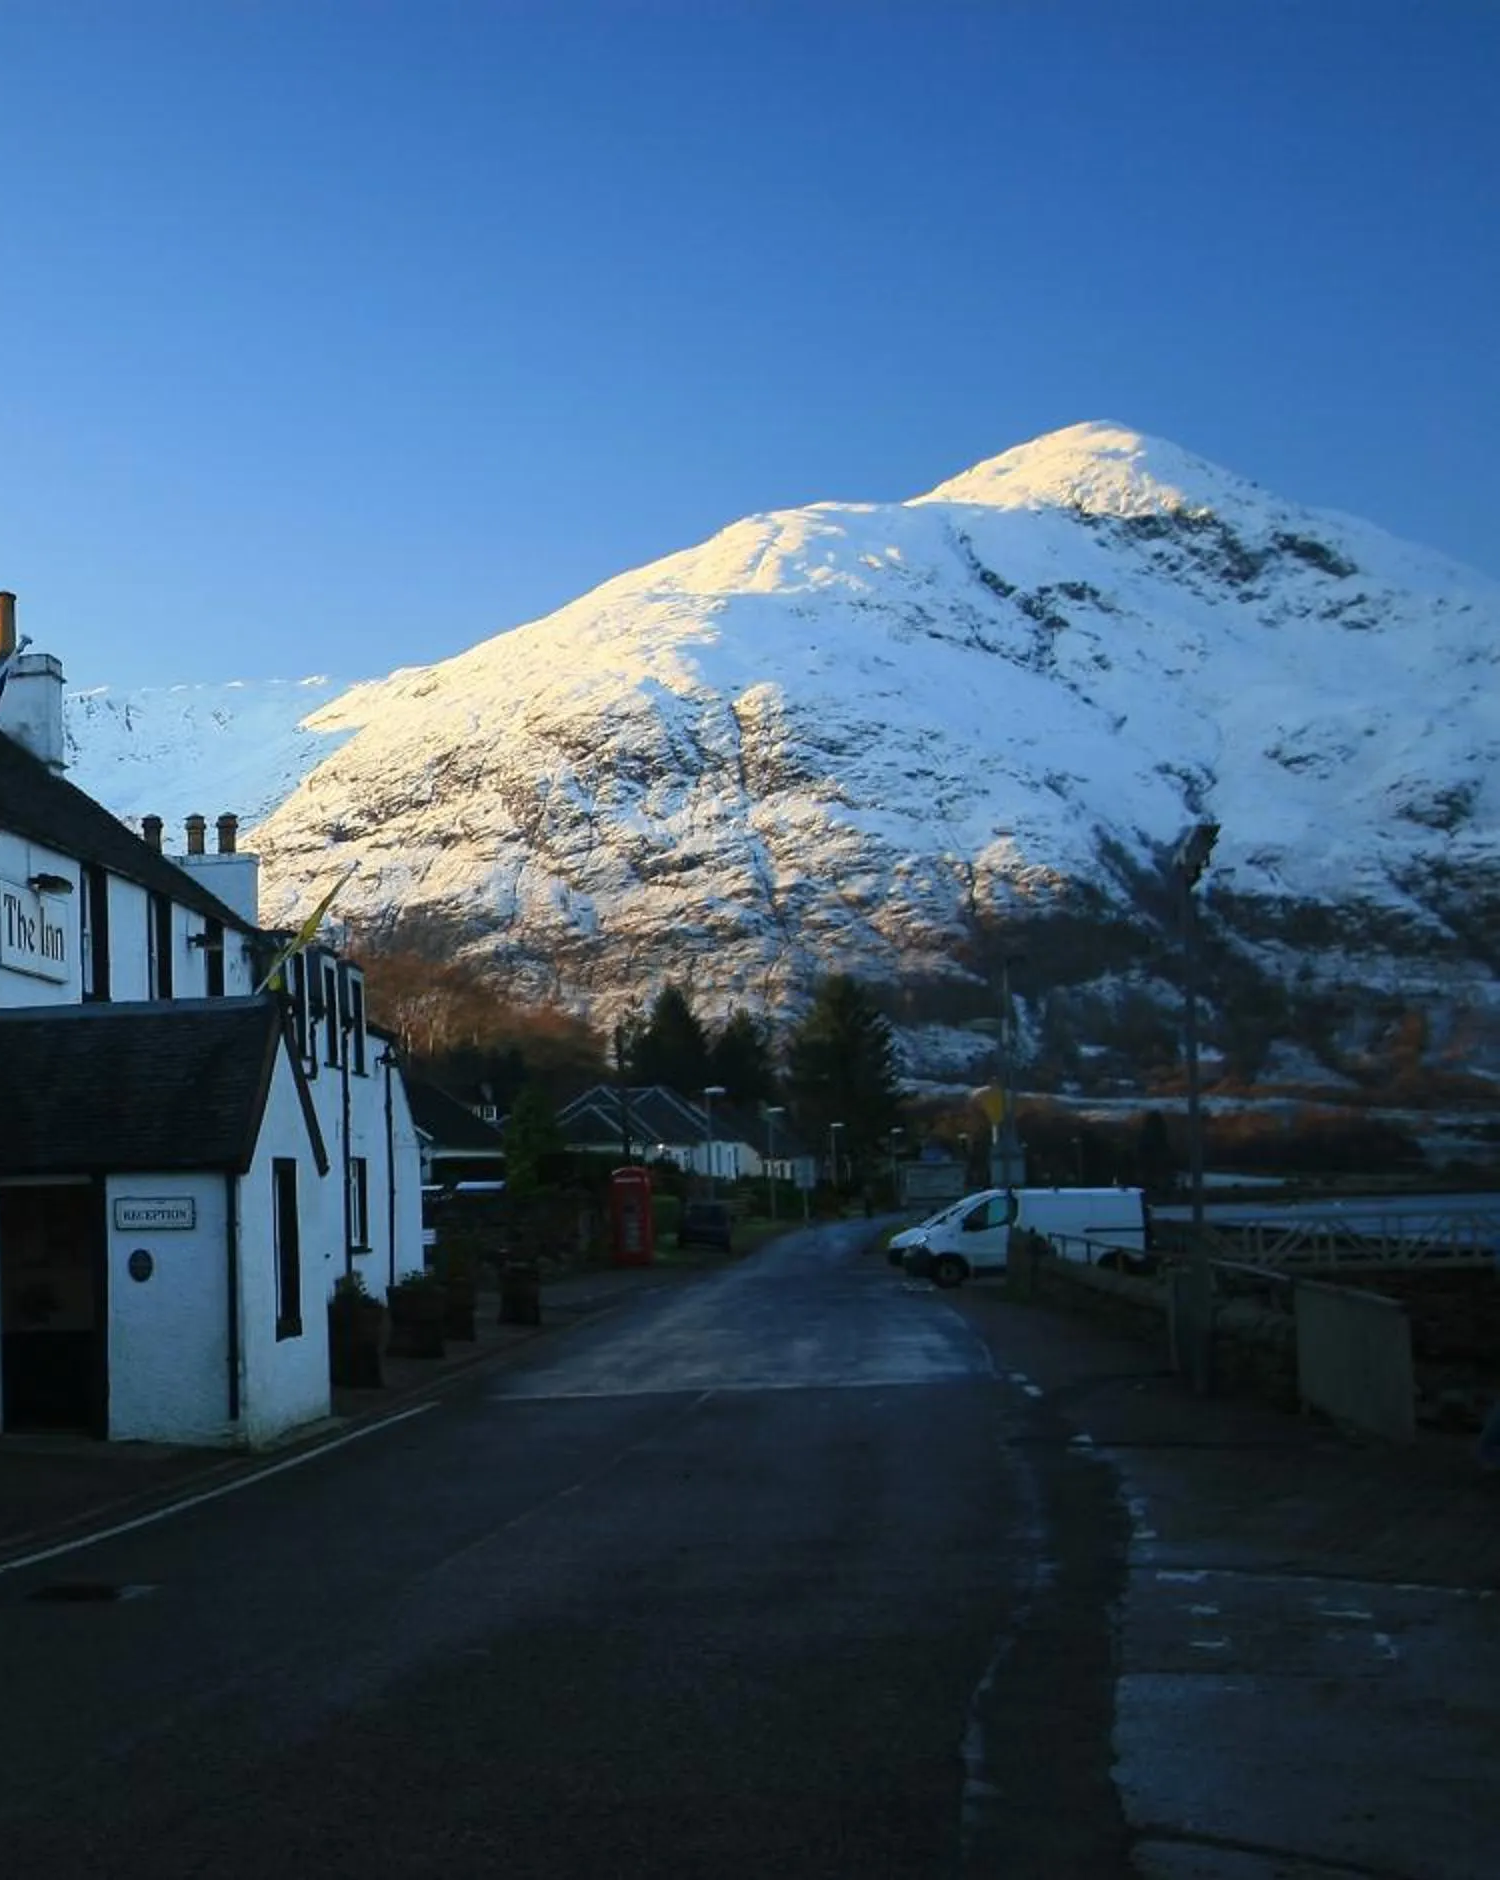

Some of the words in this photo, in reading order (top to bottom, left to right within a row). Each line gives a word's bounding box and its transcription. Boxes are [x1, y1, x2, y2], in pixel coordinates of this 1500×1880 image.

[3, 893, 35, 953] The
[40, 905, 64, 960] Inn
[123, 1208, 187, 1222] RECEPTION
